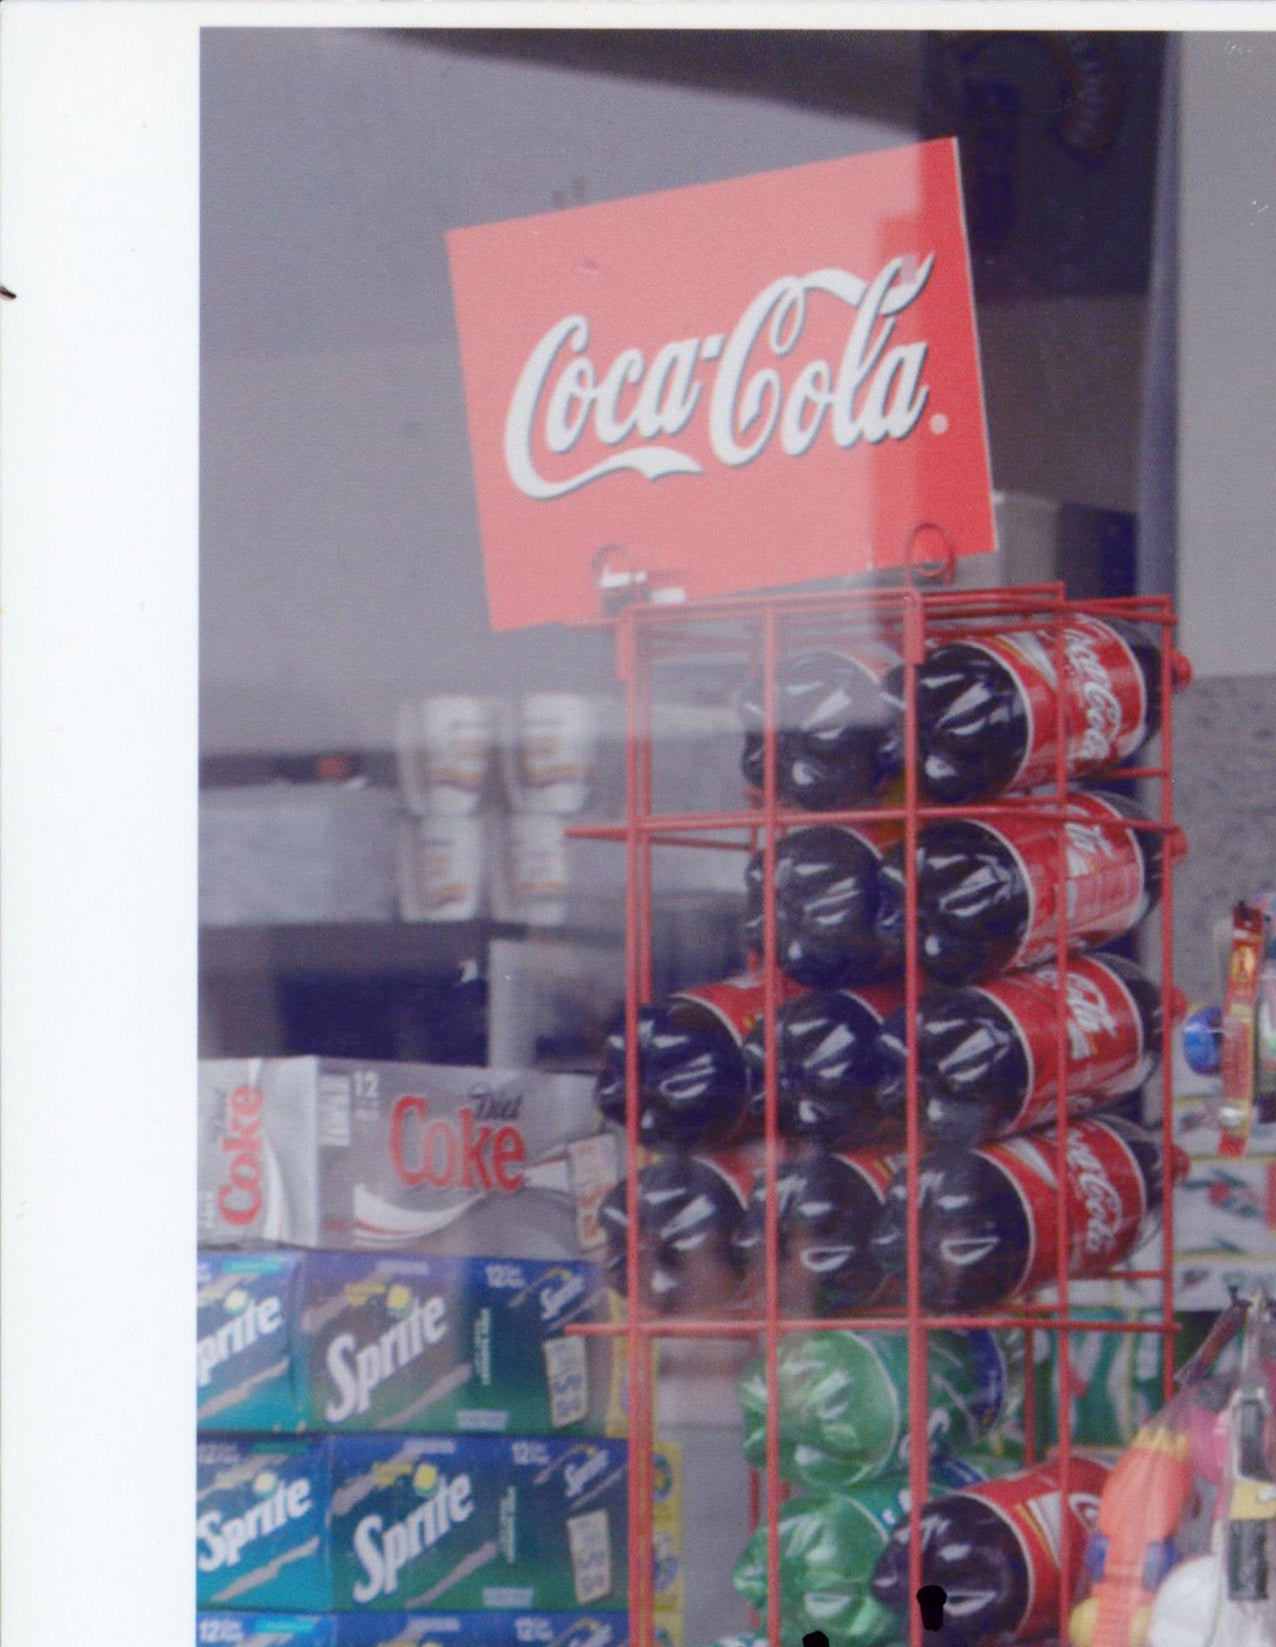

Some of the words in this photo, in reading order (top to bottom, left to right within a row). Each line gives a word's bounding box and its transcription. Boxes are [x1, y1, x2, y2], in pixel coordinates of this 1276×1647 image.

[503, 250, 936, 500] Coca-Cola
[217, 1083, 264, 1227] Coke
[389, 1094, 527, 1193] Coke
[197, 1296, 283, 1387] prite
[325, 1295, 450, 1423] Sprite
[197, 1477, 313, 1572] Sprite
[353, 1472, 475, 1605] Sprite
